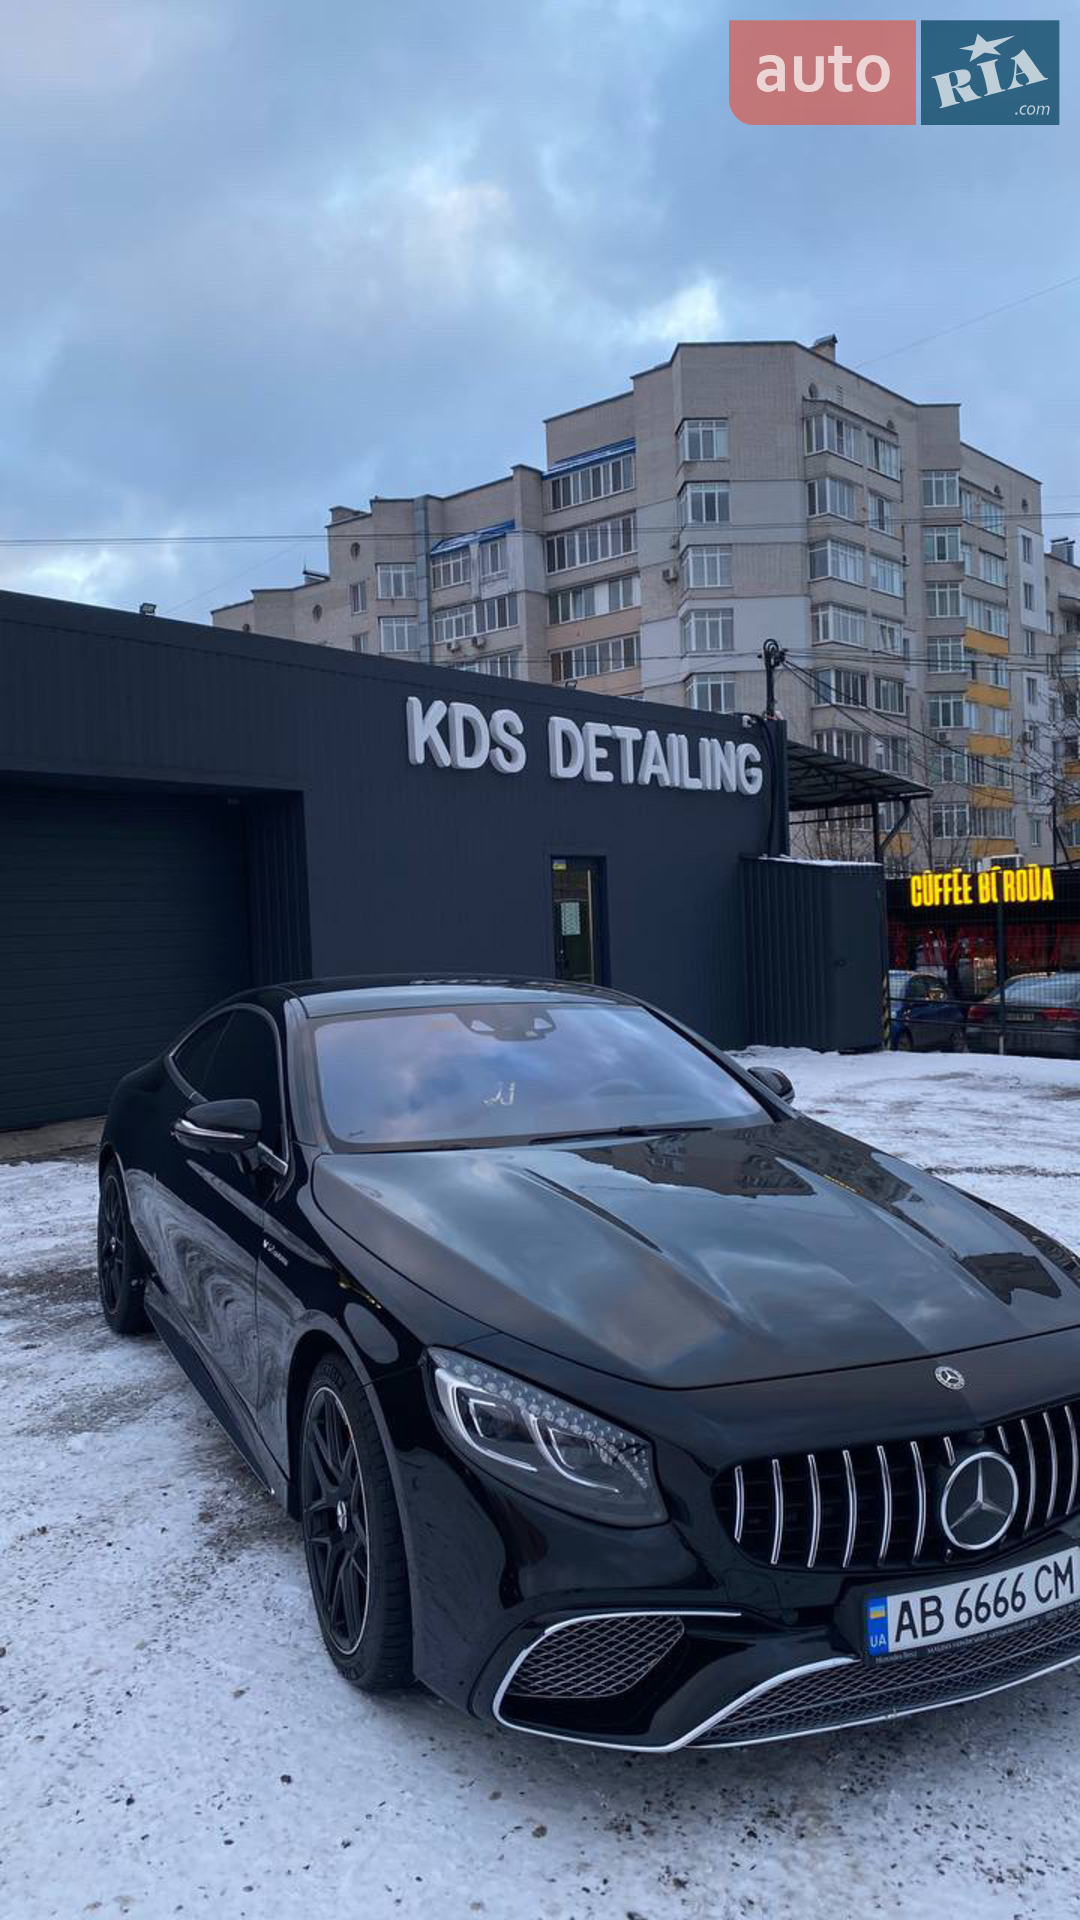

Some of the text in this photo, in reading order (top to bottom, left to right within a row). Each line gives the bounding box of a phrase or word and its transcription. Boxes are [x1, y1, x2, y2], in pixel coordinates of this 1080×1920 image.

[406, 696, 763, 796] KDS DETAILING
[869, 1633, 887, 1648] UA
[895, 1594, 944, 1643] AB
[954, 1571, 1027, 1629] 6666
[1034, 1555, 1075, 1604] CM
